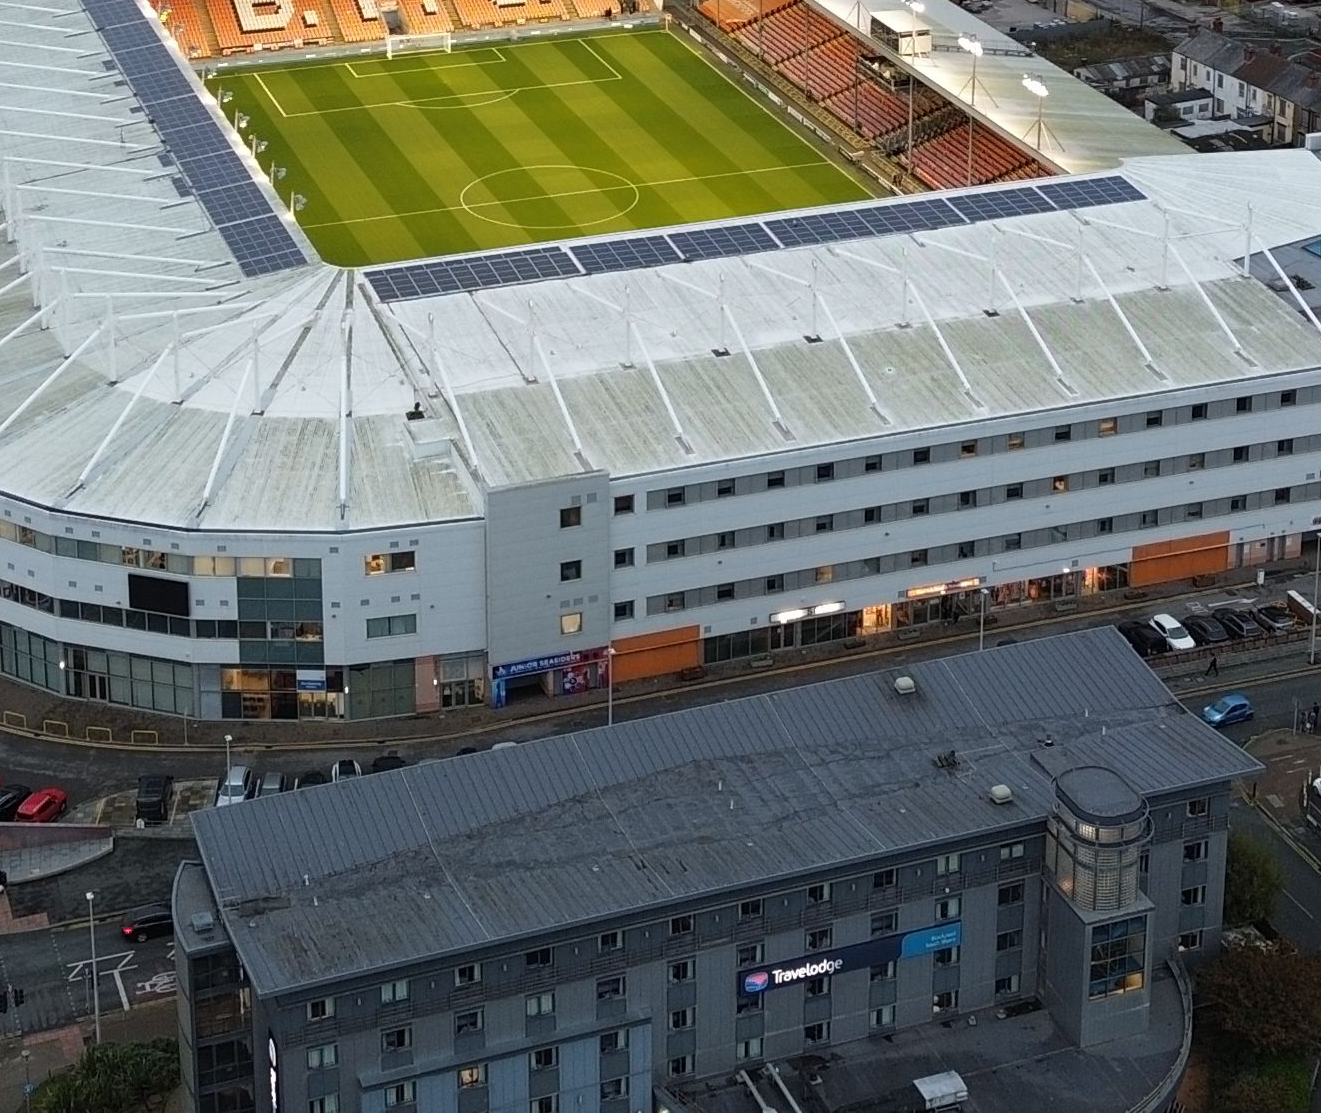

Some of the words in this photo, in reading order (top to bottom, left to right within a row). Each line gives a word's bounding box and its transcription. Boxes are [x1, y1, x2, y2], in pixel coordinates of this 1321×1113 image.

[510, 660, 538, 673] JUNIOR
[539, 652, 581, 667] SEASIDERS
[772, 958, 843, 984] Travelodge
